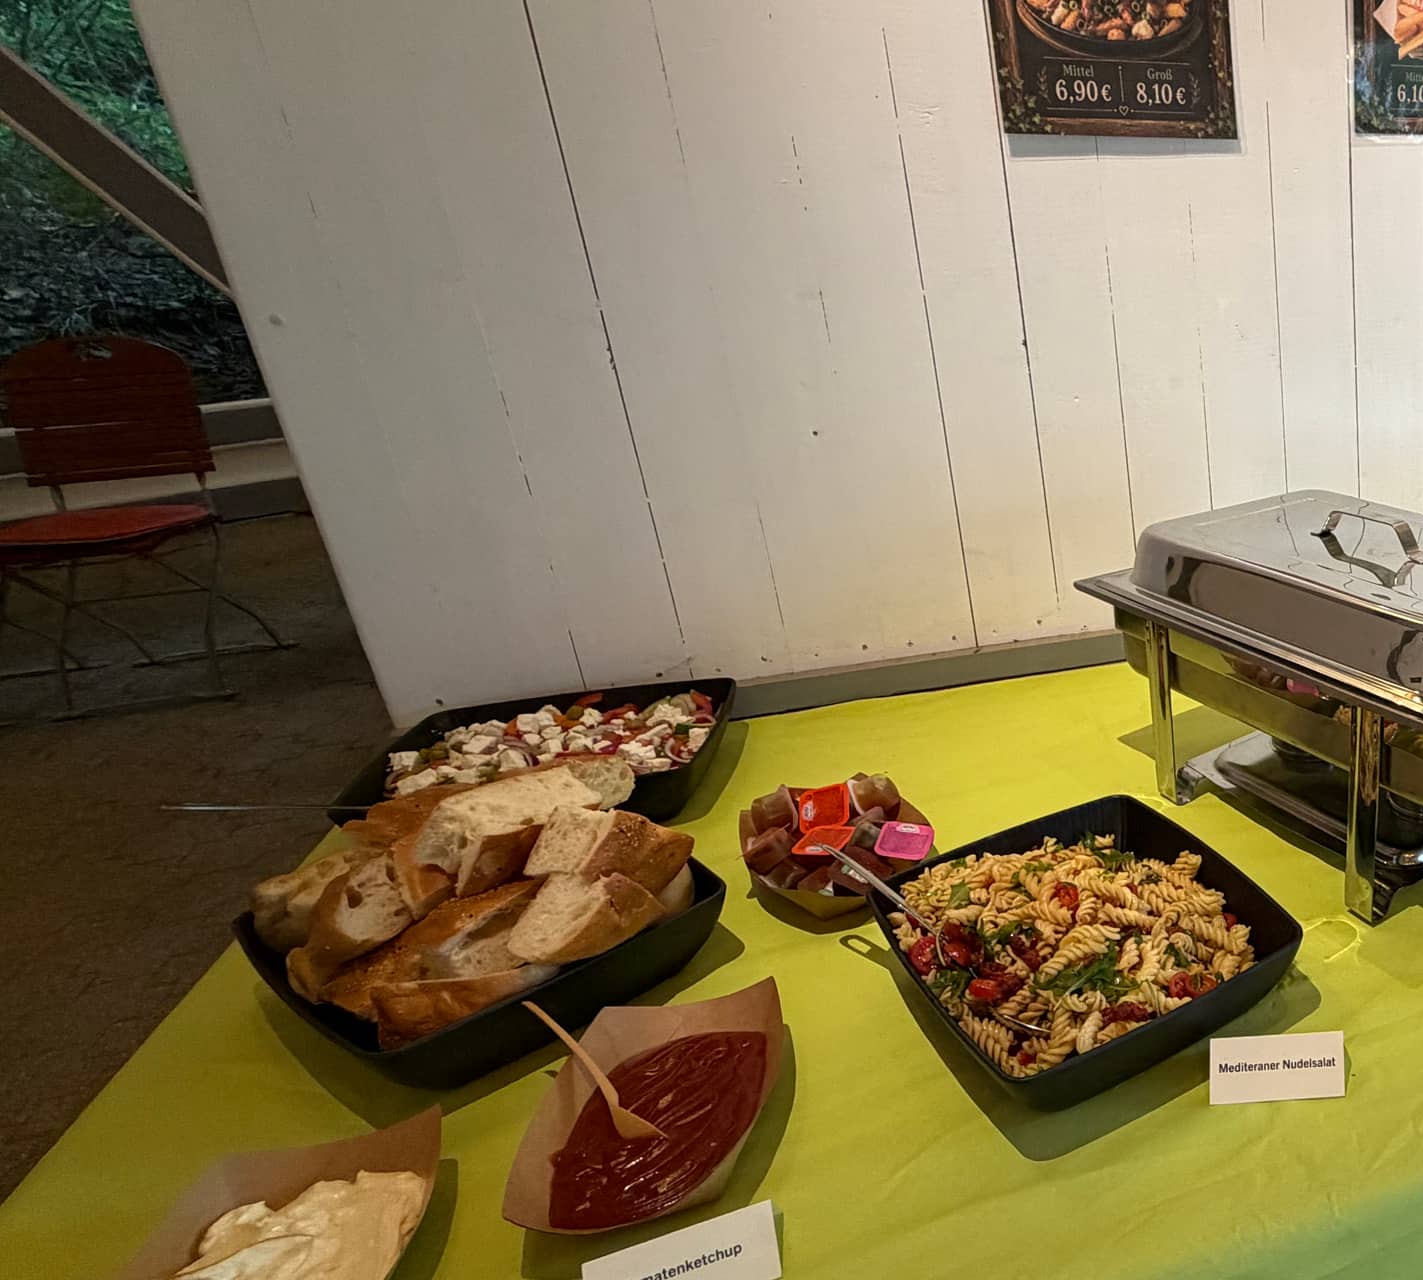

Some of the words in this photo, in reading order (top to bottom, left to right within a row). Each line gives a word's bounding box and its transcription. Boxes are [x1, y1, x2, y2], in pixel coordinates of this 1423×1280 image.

[1063, 64, 1094, 78] Mittel
[1147, 67, 1173, 81] Groß
[1218, 1061, 1280, 1074] Mediteraner
[1282, 1057, 1336, 1070] Nudelsalat
